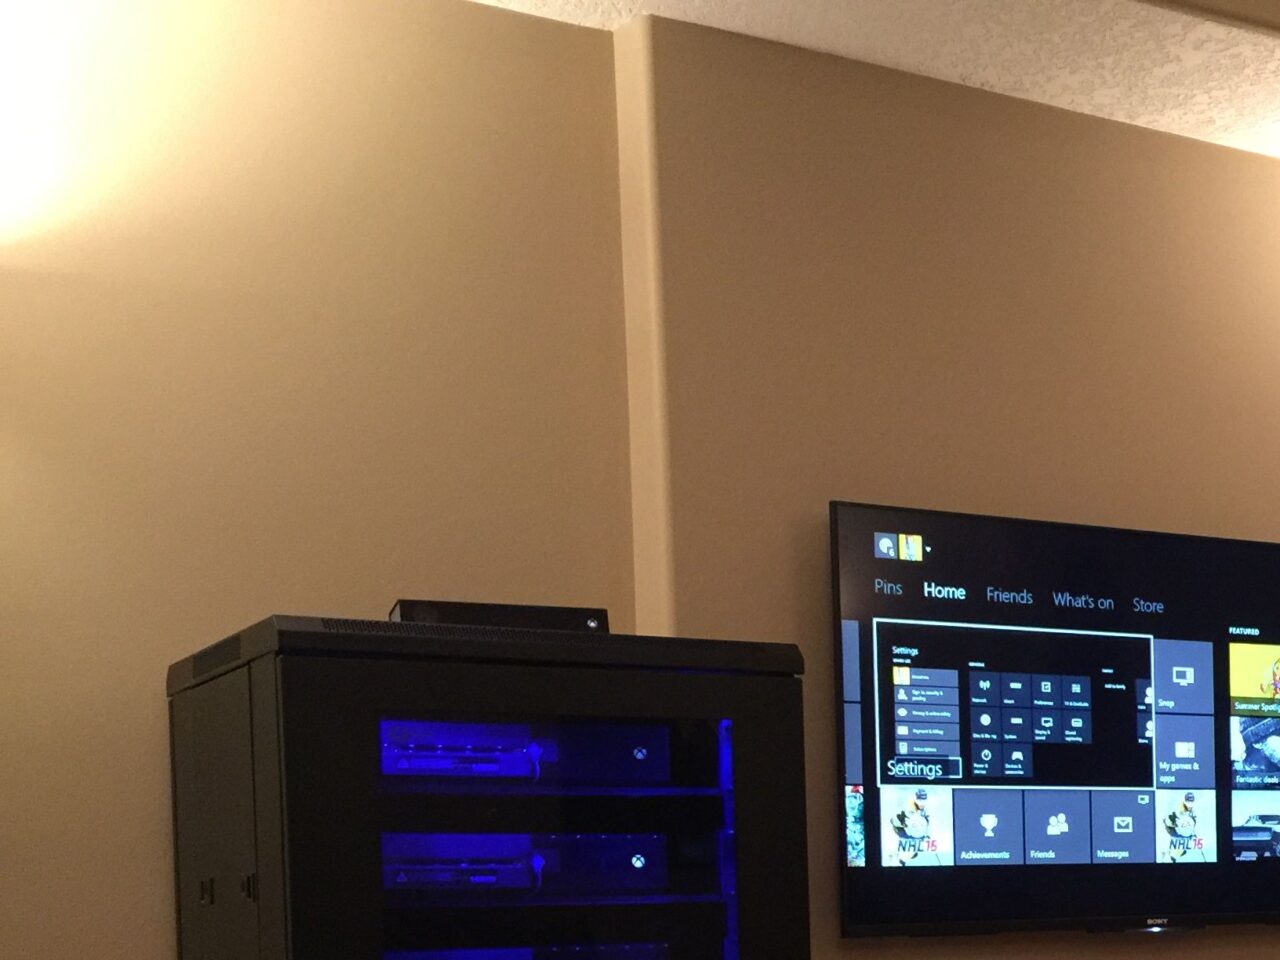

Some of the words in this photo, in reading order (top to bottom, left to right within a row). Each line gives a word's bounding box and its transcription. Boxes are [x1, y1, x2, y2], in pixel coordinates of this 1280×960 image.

[875, 579, 902, 595] Pins
[924, 582, 966, 599] Home
[987, 587, 1033, 605] Friends
[1053, 592, 1095, 608] What's
[1098, 599, 1114, 610] on
[1133, 598, 1164, 613] Store
[1229, 627, 1260, 636] FEATURED
[892, 646, 919, 656] Settings
[1158, 699, 1175, 709] Snap
[1235, 701, 1260, 711] Summer
[887, 759, 943, 780] Settings
[1159, 762, 1169, 771] My
[1171, 763, 1192, 771] games
[1159, 775, 1175, 783] apps
[1236, 775, 1263, 784] Fantastic
[1264, 776, 1278, 784] deals
[960, 851, 1010, 859] Achievements
[1030, 850, 1055, 859] Friends
[1097, 850, 1129, 860] Messages
